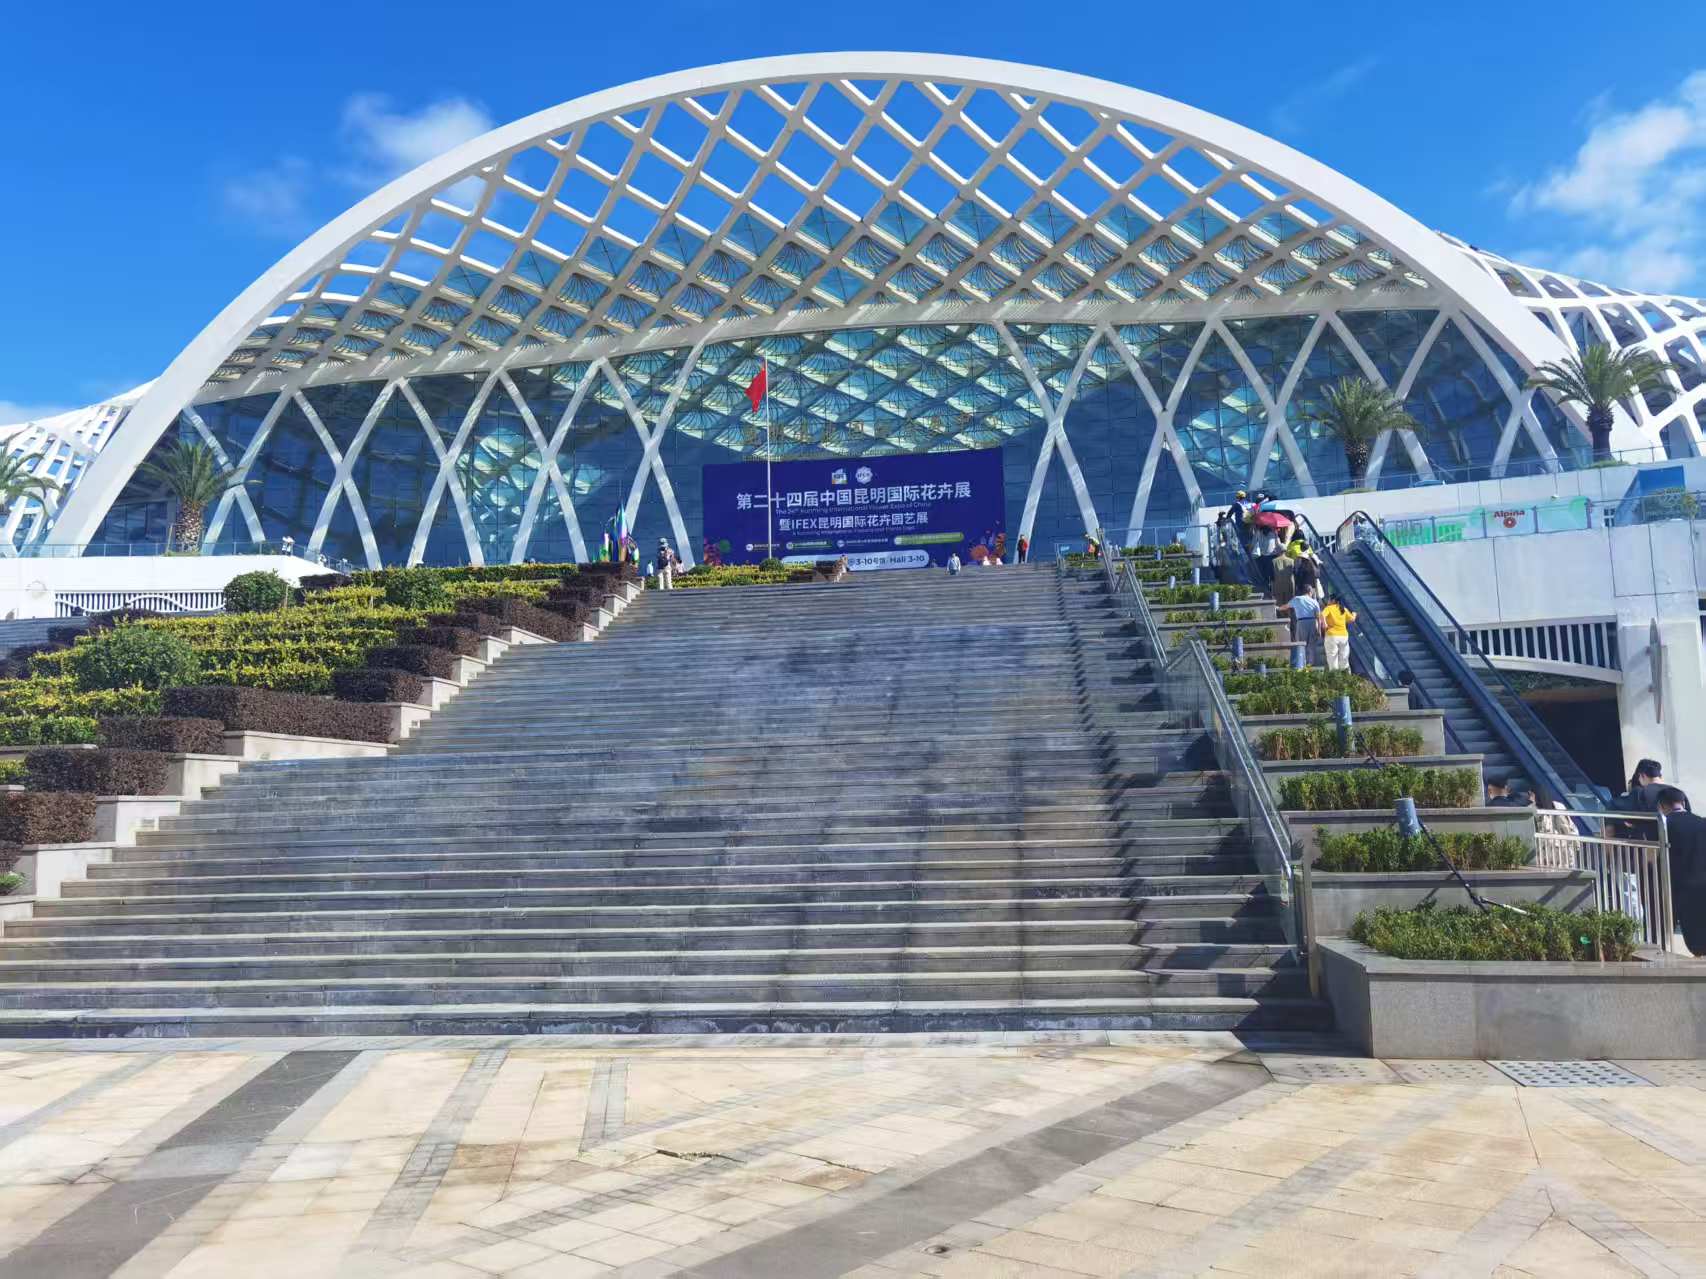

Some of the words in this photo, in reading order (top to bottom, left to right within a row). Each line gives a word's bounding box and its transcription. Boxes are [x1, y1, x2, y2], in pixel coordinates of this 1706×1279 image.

[736, 481, 972, 511] 第二十四届中国昆明国际花卉展
[779, 511, 929, 531] 暨IFEX昆明国际花卉园艺展
[1494, 510, 1525, 519] Alpina
